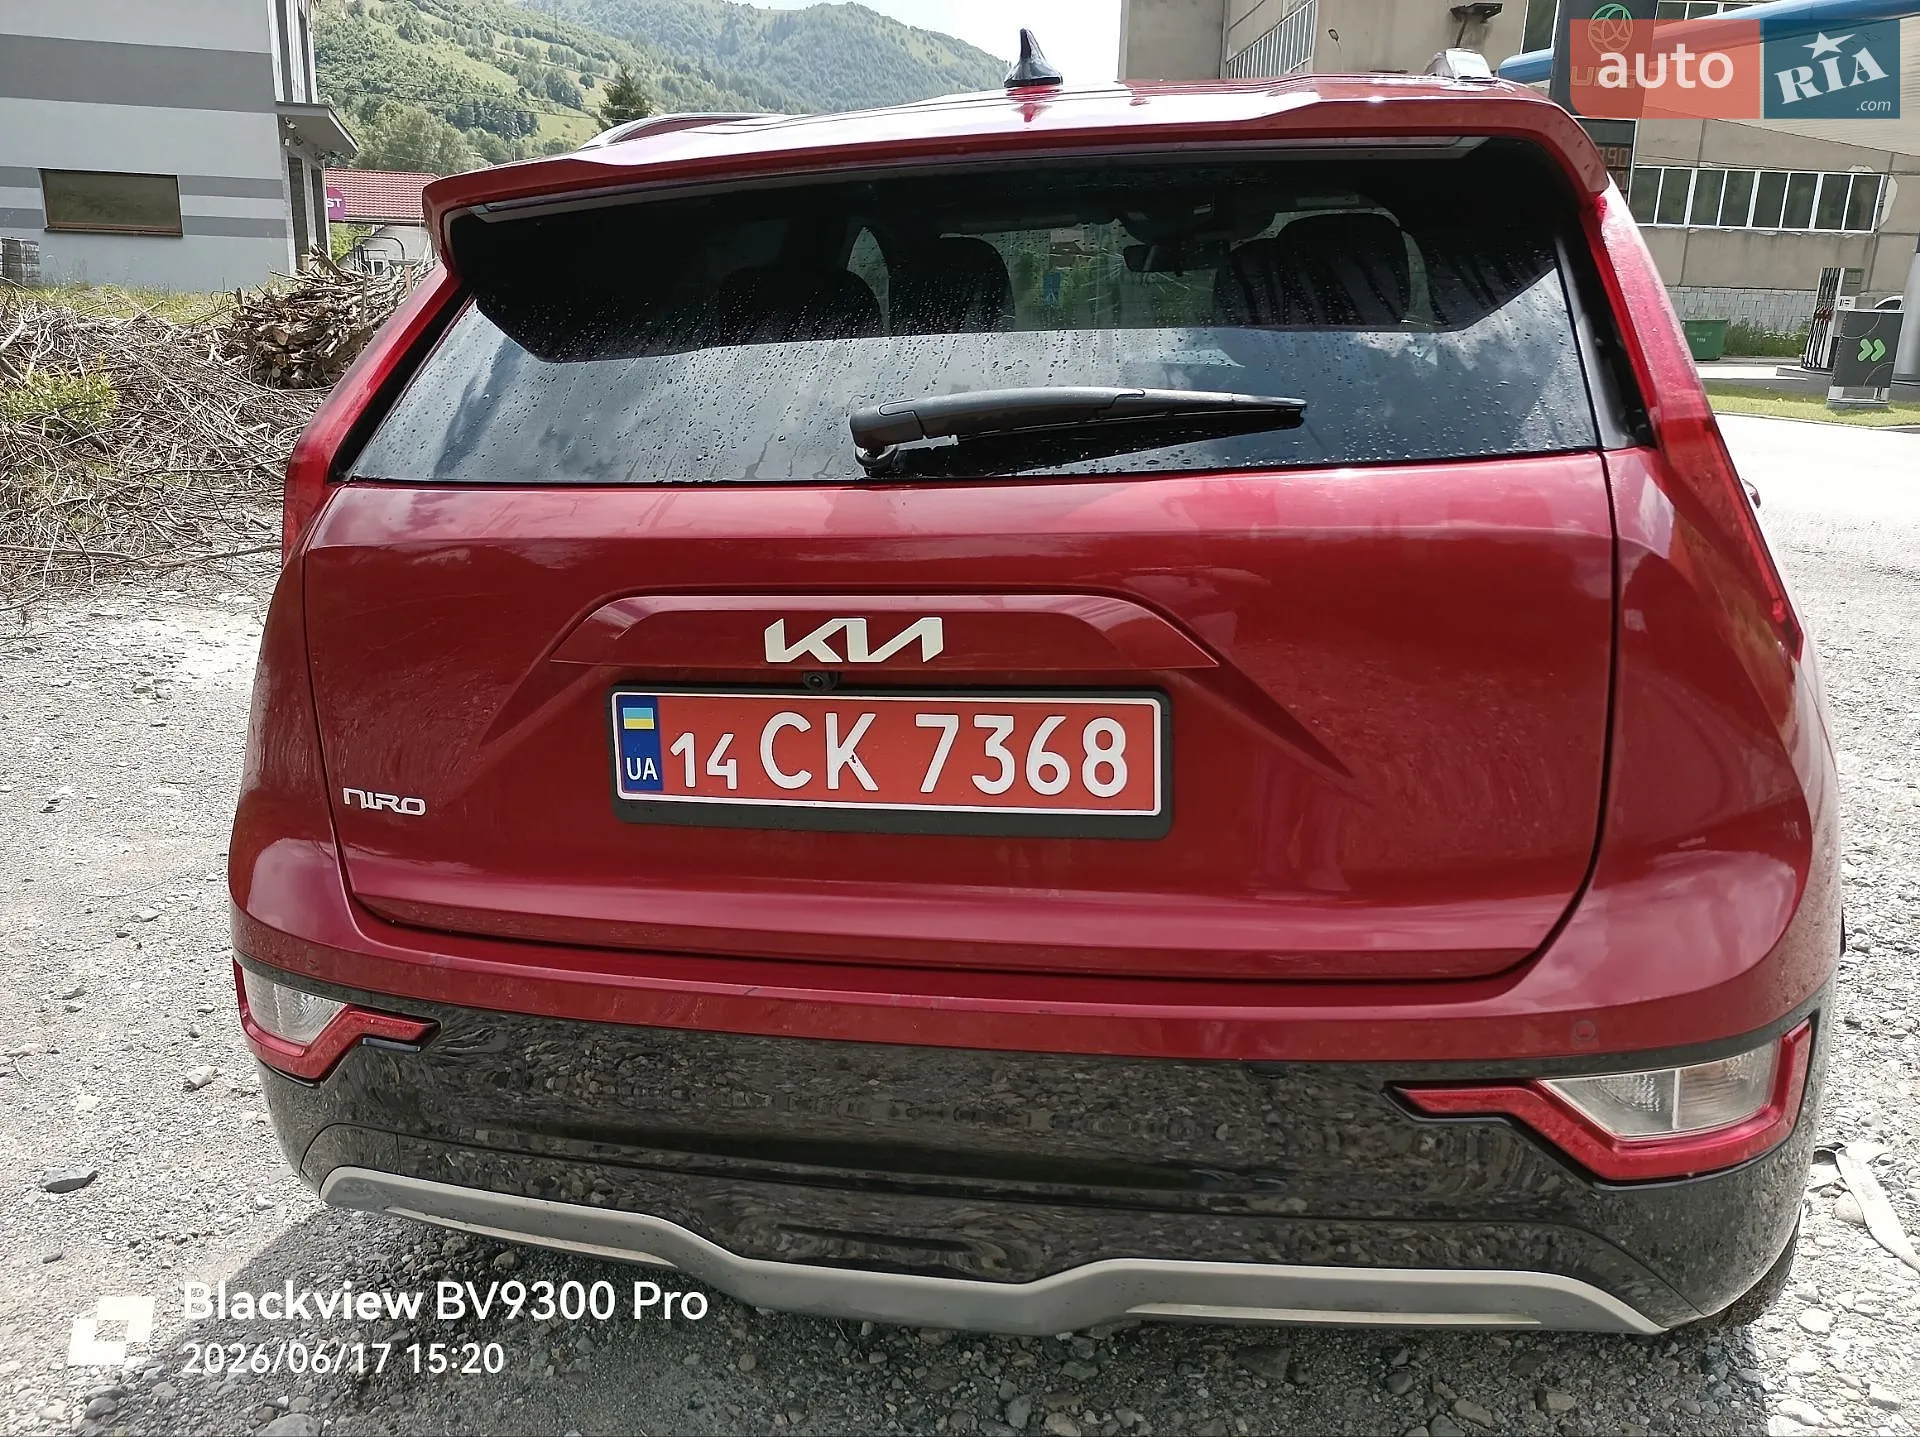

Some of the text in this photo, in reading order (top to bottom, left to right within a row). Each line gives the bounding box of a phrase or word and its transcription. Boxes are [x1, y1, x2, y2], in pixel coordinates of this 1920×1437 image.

[764, 617, 944, 663] KIA
[626, 757, 658, 781] UA
[670, 711, 1128, 798] 14 CK 7368
[343, 787, 426, 816] NIRO
